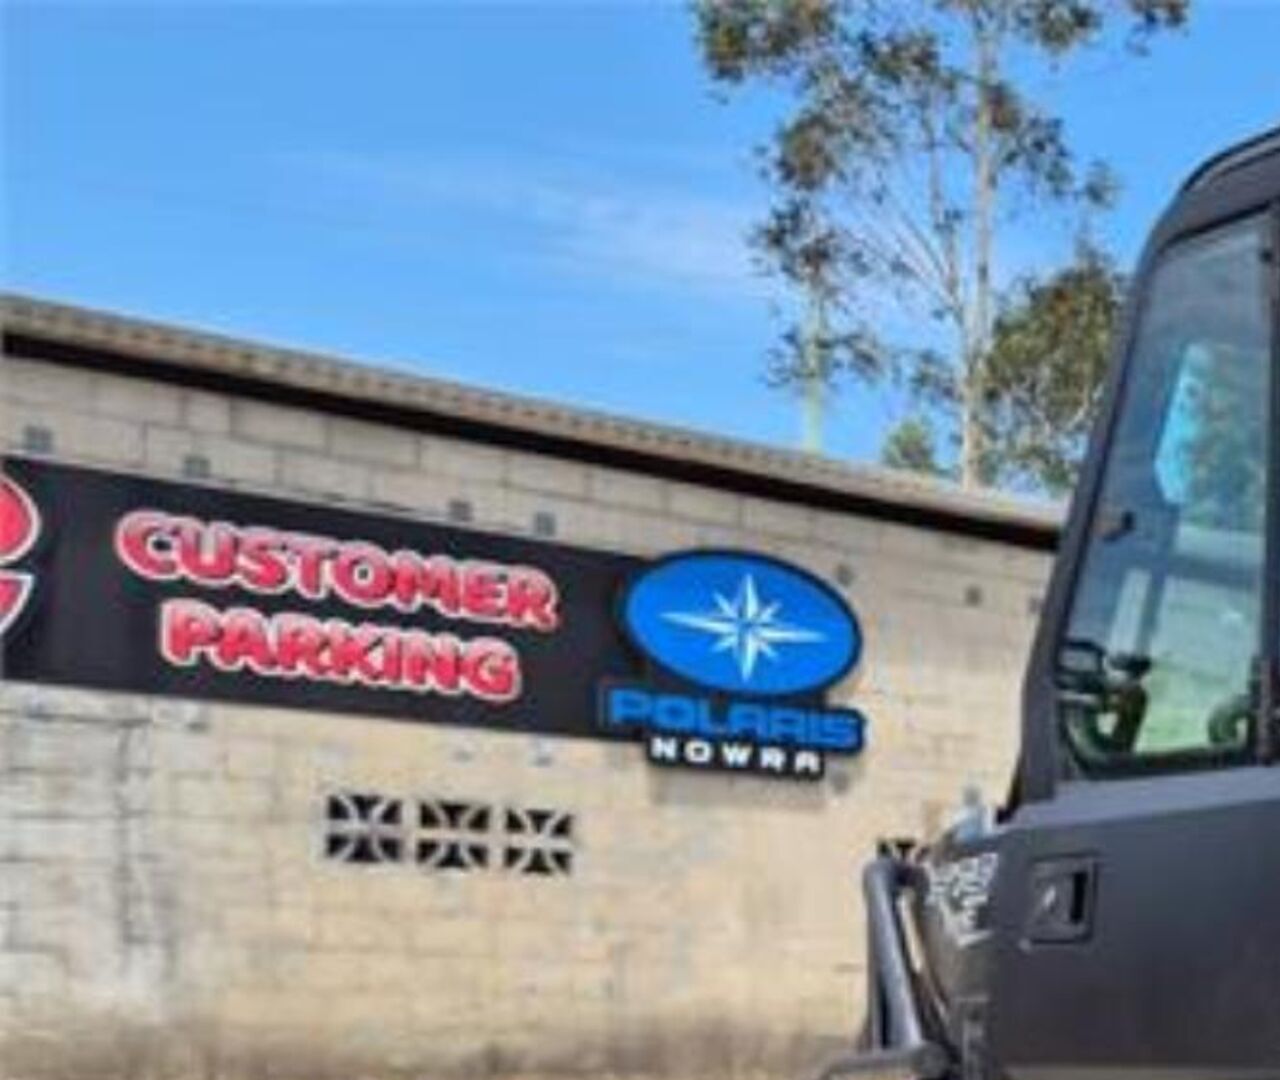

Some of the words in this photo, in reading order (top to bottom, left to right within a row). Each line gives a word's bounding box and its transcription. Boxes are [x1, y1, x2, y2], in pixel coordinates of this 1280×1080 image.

[116, 510, 560, 632] CUSTOMER
[160, 598, 522, 701] PARKING
[610, 688, 860, 750] POLARIS
[650, 736, 821, 774] NOWRA
